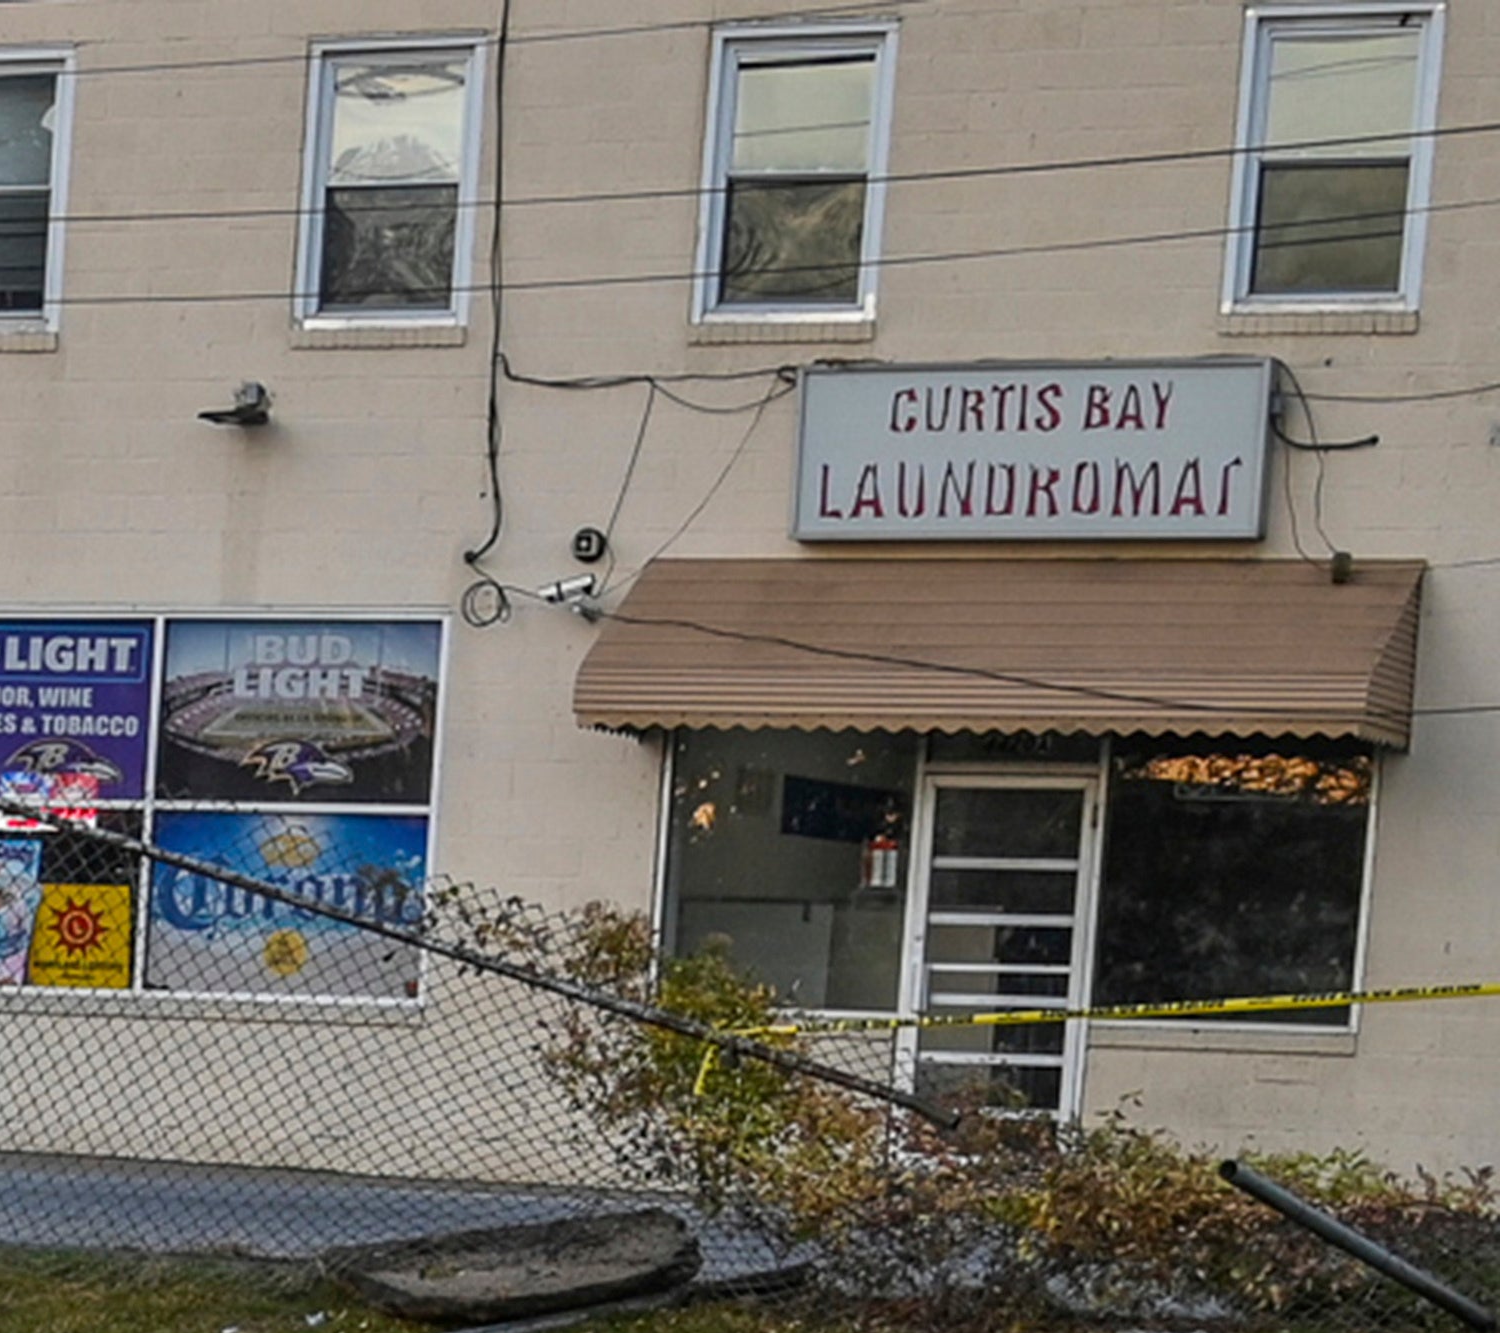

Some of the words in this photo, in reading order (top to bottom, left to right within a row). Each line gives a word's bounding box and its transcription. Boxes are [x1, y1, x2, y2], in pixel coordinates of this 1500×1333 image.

[889, 382, 1064, 433] CURTIS
[1082, 380, 1174, 431] BAY
[819, 456, 1243, 520] LAUNDROMAT
[3, 636, 138, 672] LIGHT
[255, 634, 353, 666] BUD
[38, 687, 93, 708] WINE
[233, 667, 369, 699] LIGHT
[41, 714, 140, 736] TOBACCO
